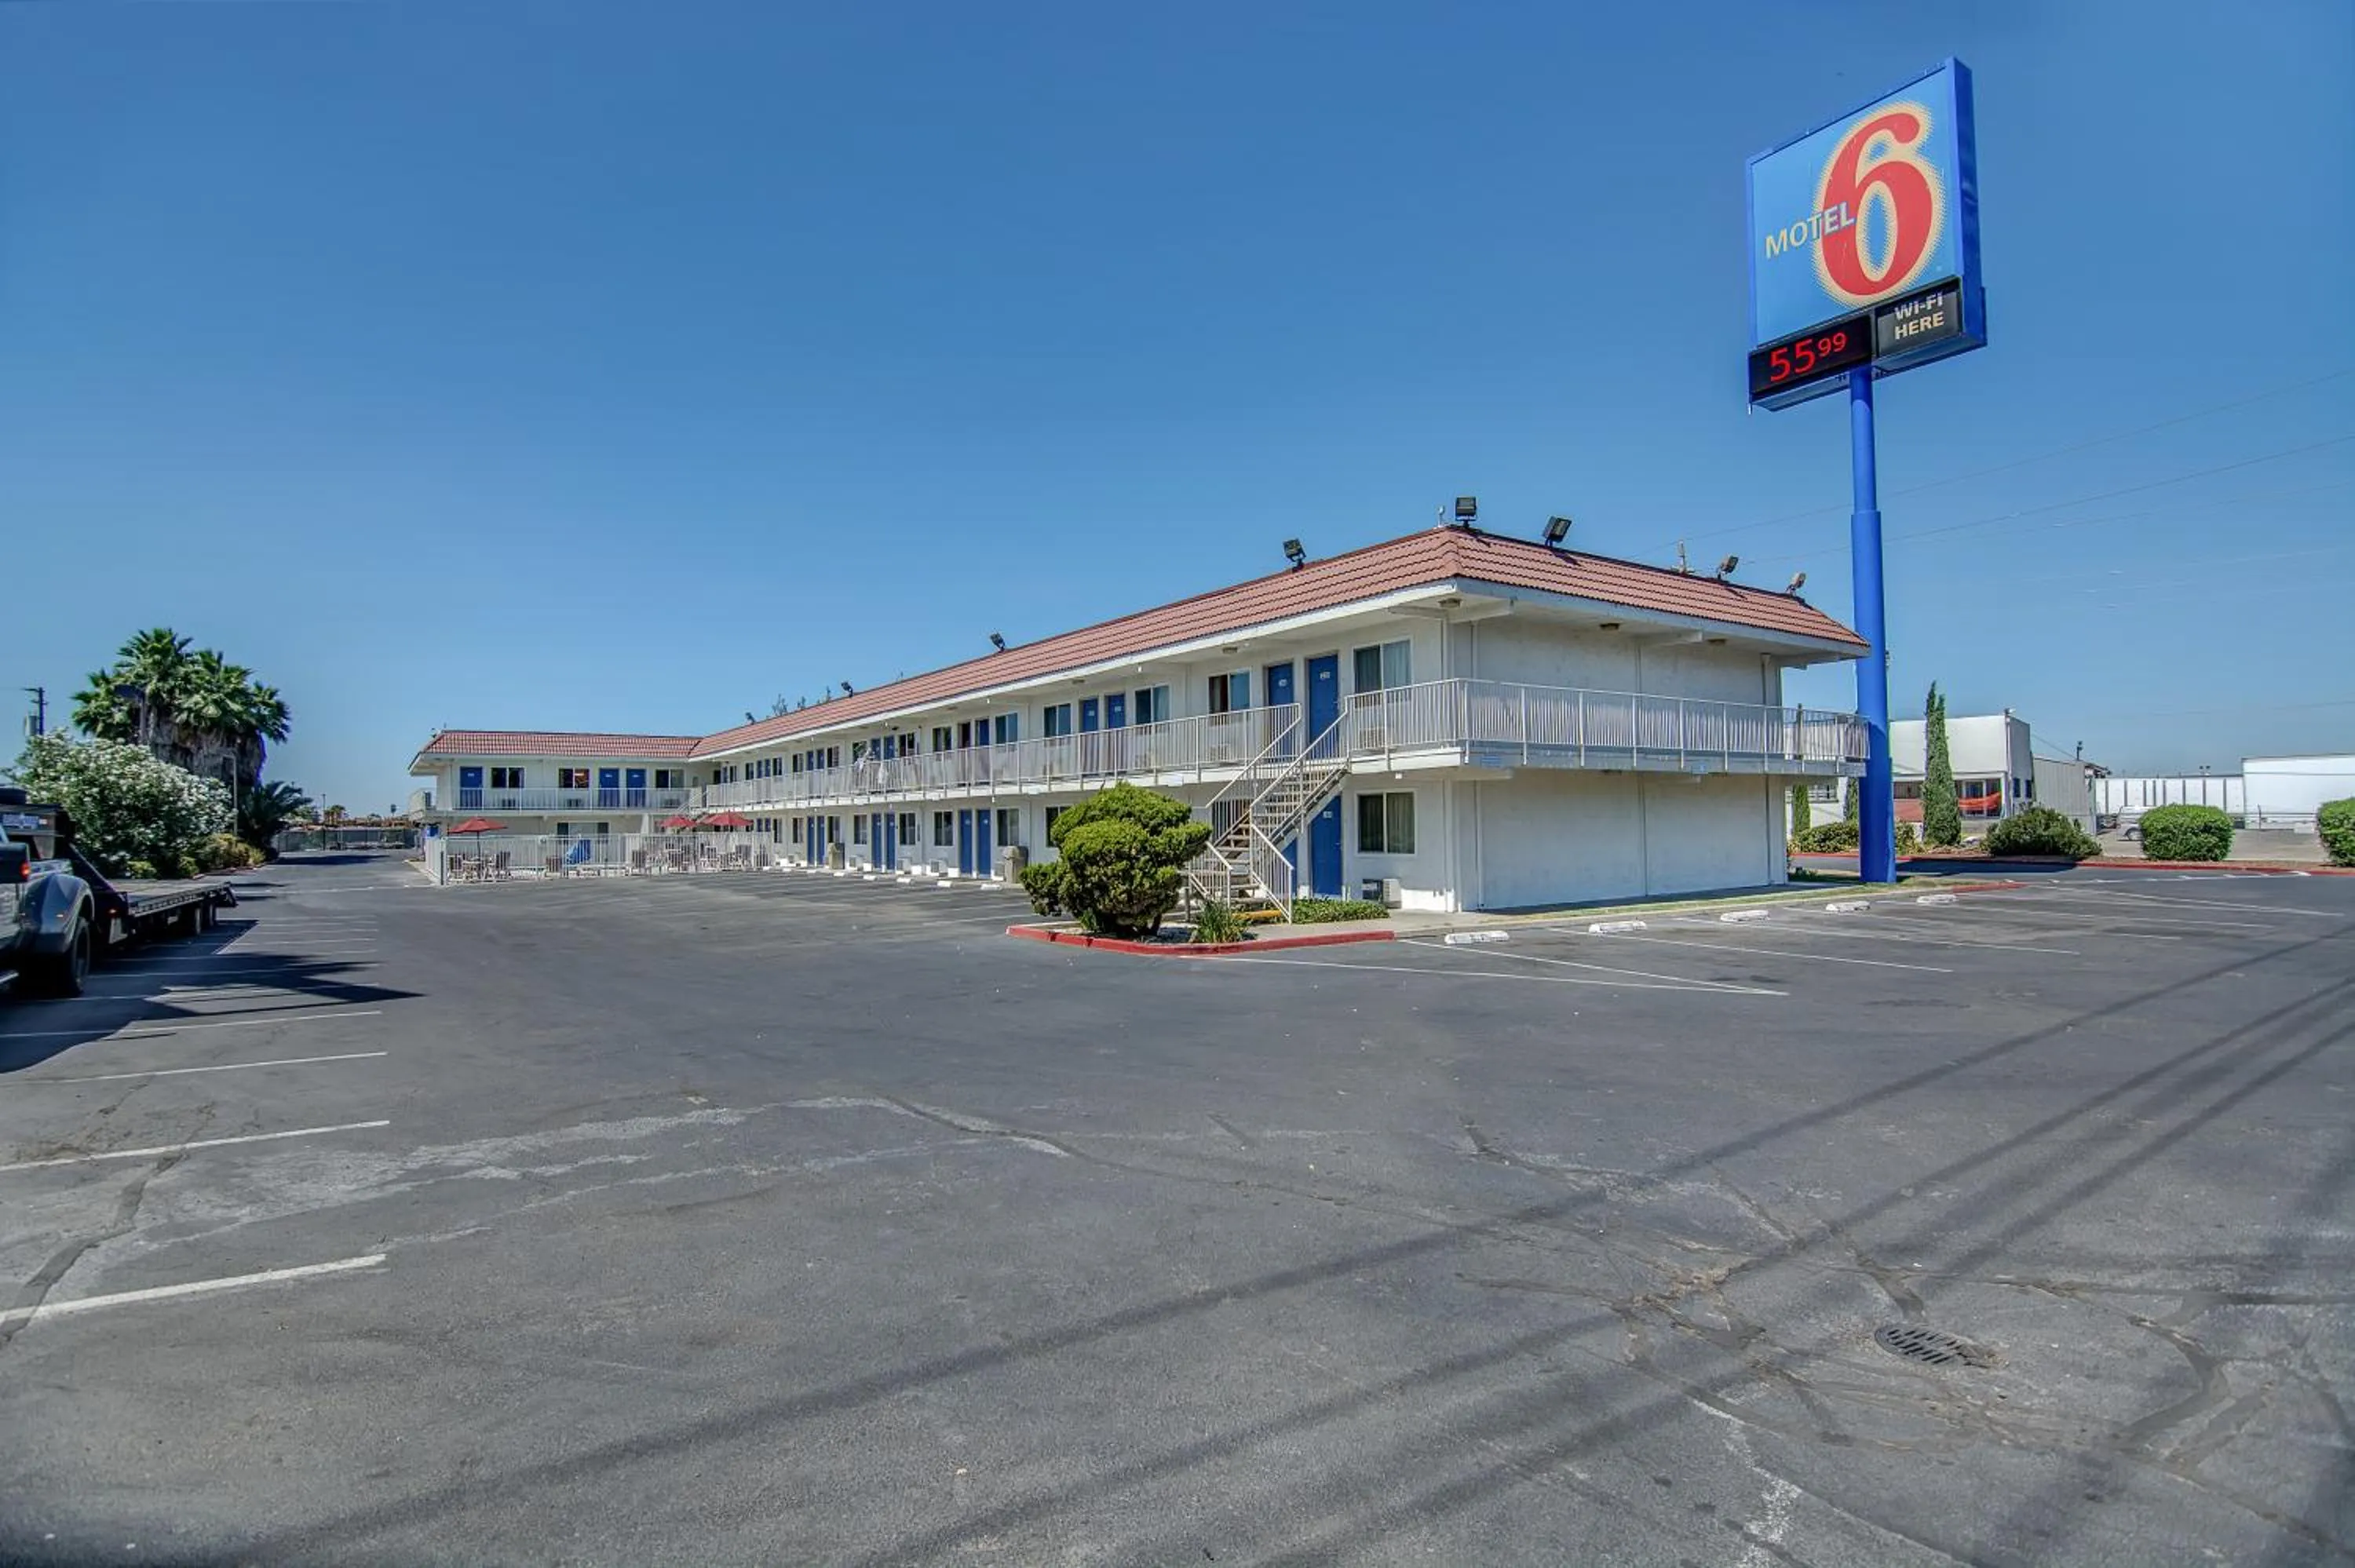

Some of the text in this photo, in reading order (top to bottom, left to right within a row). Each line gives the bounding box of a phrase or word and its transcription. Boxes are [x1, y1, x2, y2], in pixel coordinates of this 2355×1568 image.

[1765, 111, 1934, 297] MOTEL 6
[1894, 312, 1944, 340] HERE
